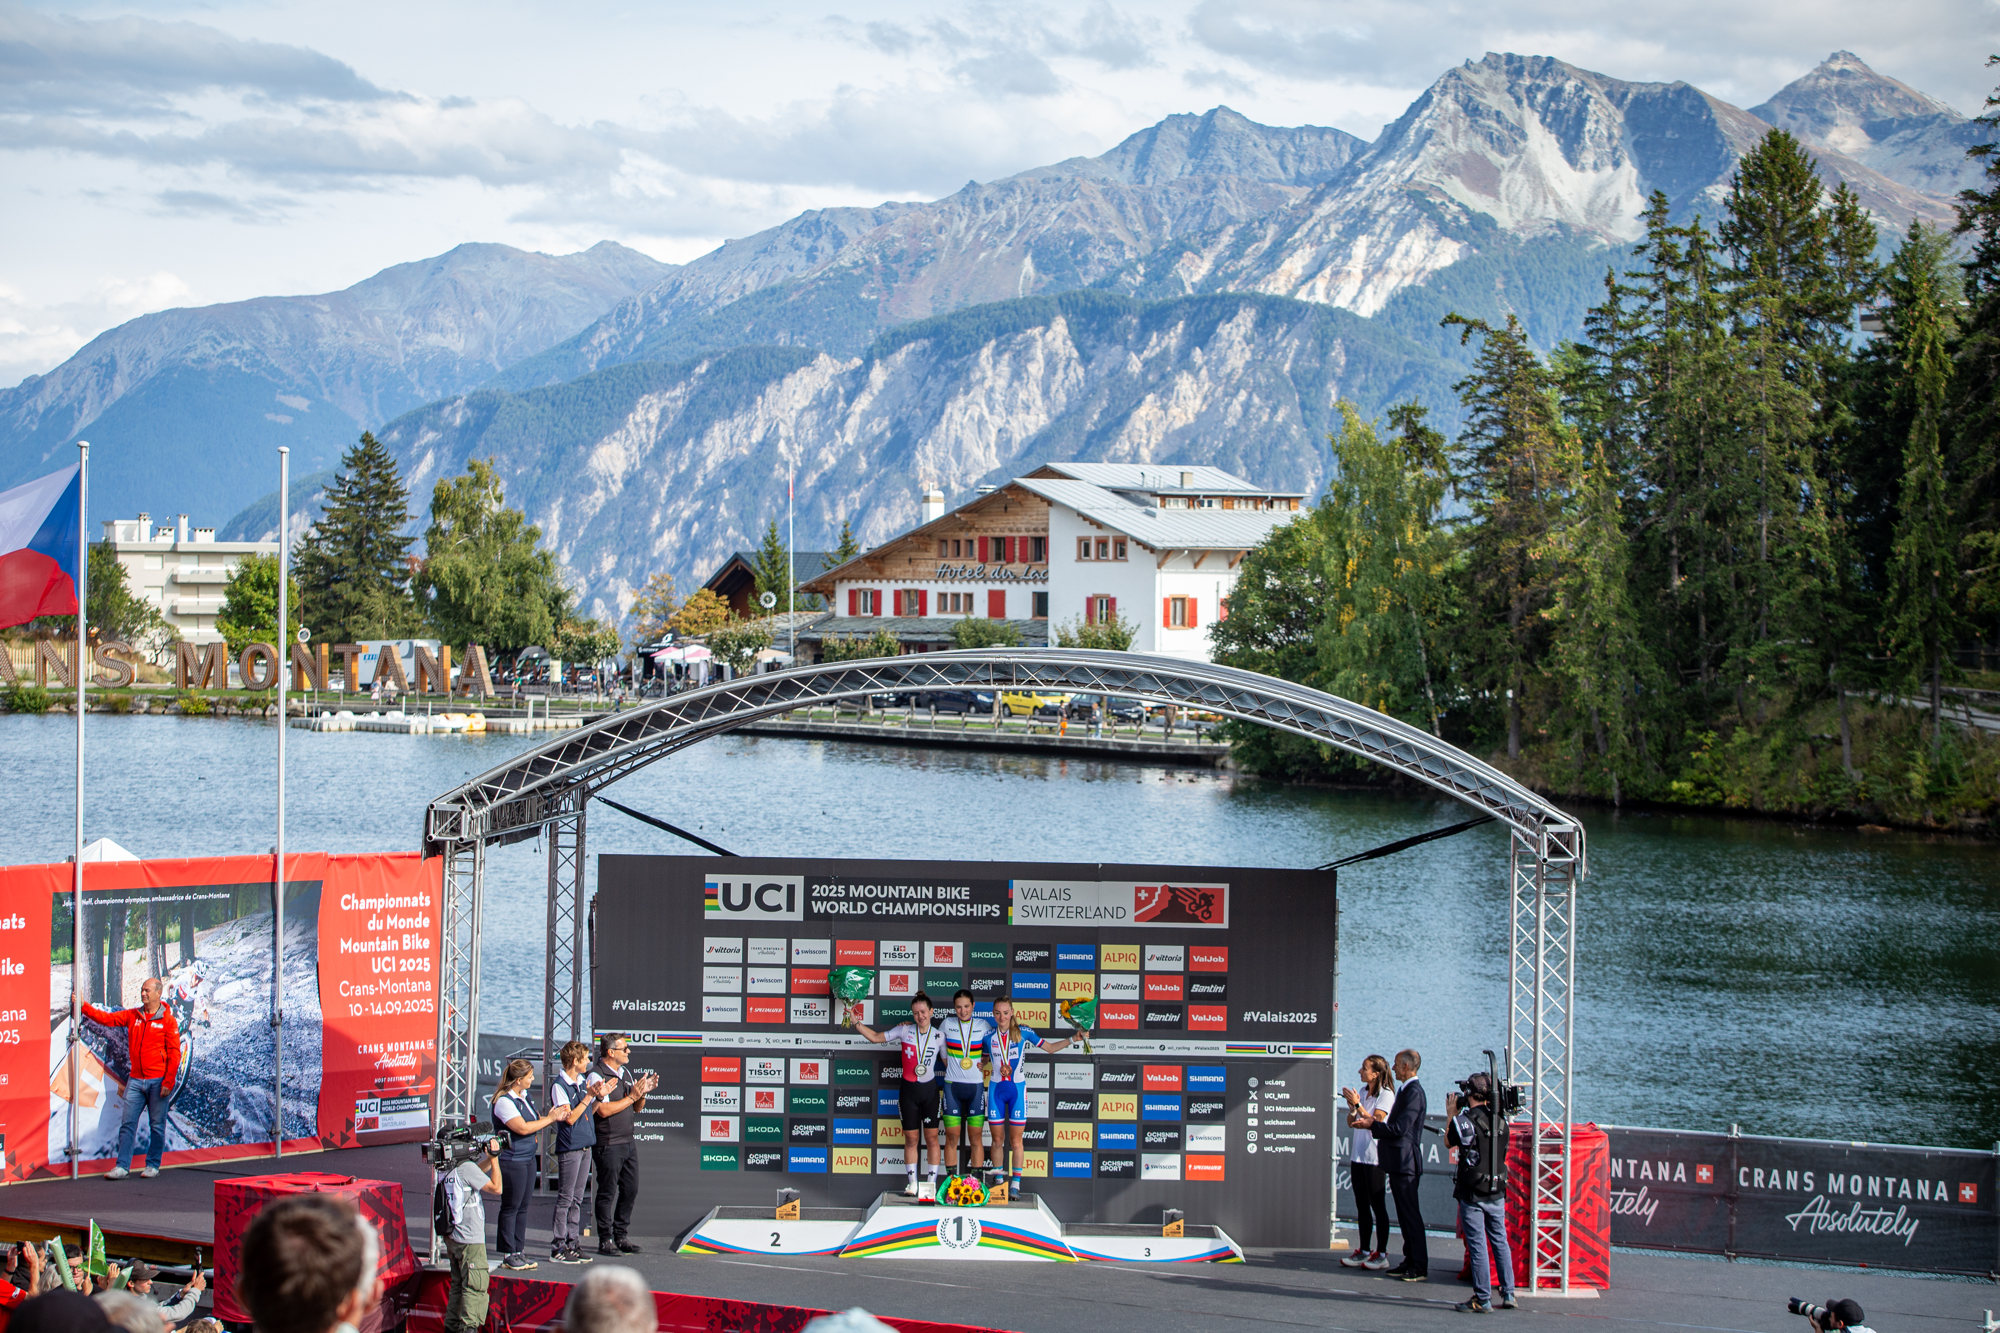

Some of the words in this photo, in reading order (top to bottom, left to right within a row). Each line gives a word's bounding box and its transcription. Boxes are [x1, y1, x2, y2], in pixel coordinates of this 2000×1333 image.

[935, 562, 986, 579] Hotel
[990, 565, 1016, 579] du
[175, 641, 495, 697] MONTANA
[722, 883, 796, 912] UCI
[811, 884, 846, 897] 2025
[849, 885, 933, 899] MOUNTAIN
[937, 886, 970, 900] BIKE
[1020, 887, 1072, 901] VALAIS
[340, 891, 431, 914] Championnats
[811, 901, 868, 914] WORLD
[871, 902, 1001, 917] CHAMPIONSHIPS
[1020, 904, 1127, 920] SWITZERLAND
[367, 913, 384, 931] du
[386, 911, 430, 930] Monde
[340, 935, 399, 954] Mountain
[402, 932, 430, 951] Bike
[882, 952, 917, 960] TISSOT
[1103, 952, 1137, 964] ALPIQ
[1192, 955, 1225, 963] ValJob
[0, 957, 25, 977] ike
[371, 955, 396, 974] UCI
[399, 957, 431, 972] 2025
[339, 977, 432, 997] Crans-Montana
[1058, 982, 1092, 993] ALPIQ
[1148, 984, 1180, 992] ValJob
[1190, 984, 1226, 993] Santini
[612, 999, 686, 1012] #Valais2025
[0, 1008, 27, 1022] ana
[793, 1009, 828, 1017] TISSOT
[1015, 1010, 1047, 1022] ALPIQ
[1146, 1012, 1180, 1021] Santini
[1191, 1014, 1224, 1022] ValJob
[1243, 1011, 1318, 1023] #Valais2025
[632, 1033, 656, 1043] UCI
[357, 1042, 384, 1055] CRANS
[387, 1039, 425, 1053] MONTANA
[1267, 1044, 1291, 1055] UCI
[374, 1051, 417, 1070] Absolutely
[923, 1046, 935, 1067] SUI
[748, 1068, 782, 1076] TISSOT
[1100, 1073, 1136, 1082] Santini
[1146, 1074, 1179, 1082] ValJob
[1189, 1075, 1224, 1083] SHIMANO
[703, 1097, 738, 1105] TISSOT
[1056, 1101, 1091, 1110] Santini
[359, 1101, 379, 1114] UCI
[1101, 1102, 1135, 1113] ALPIQ
[793, 1124, 826, 1132] OCHSNER
[1057, 1130, 1090, 1142] ALPIQ
[1146, 1131, 1179, 1139] OCHSNER
[790, 1156, 825, 1164] SHIMANO
[835, 1155, 869, 1168] ALPIQ
[1055, 1161, 1090, 1169] SHIMANO
[1738, 1166, 1815, 1192] CRANS
[1827, 1172, 1949, 1202] MONTANA
[1784, 1194, 1920, 1247] Absolutely
[952, 1215, 963, 1242] 1
[770, 1231, 781, 1247] 2
[1144, 1247, 1151, 1257] 3
